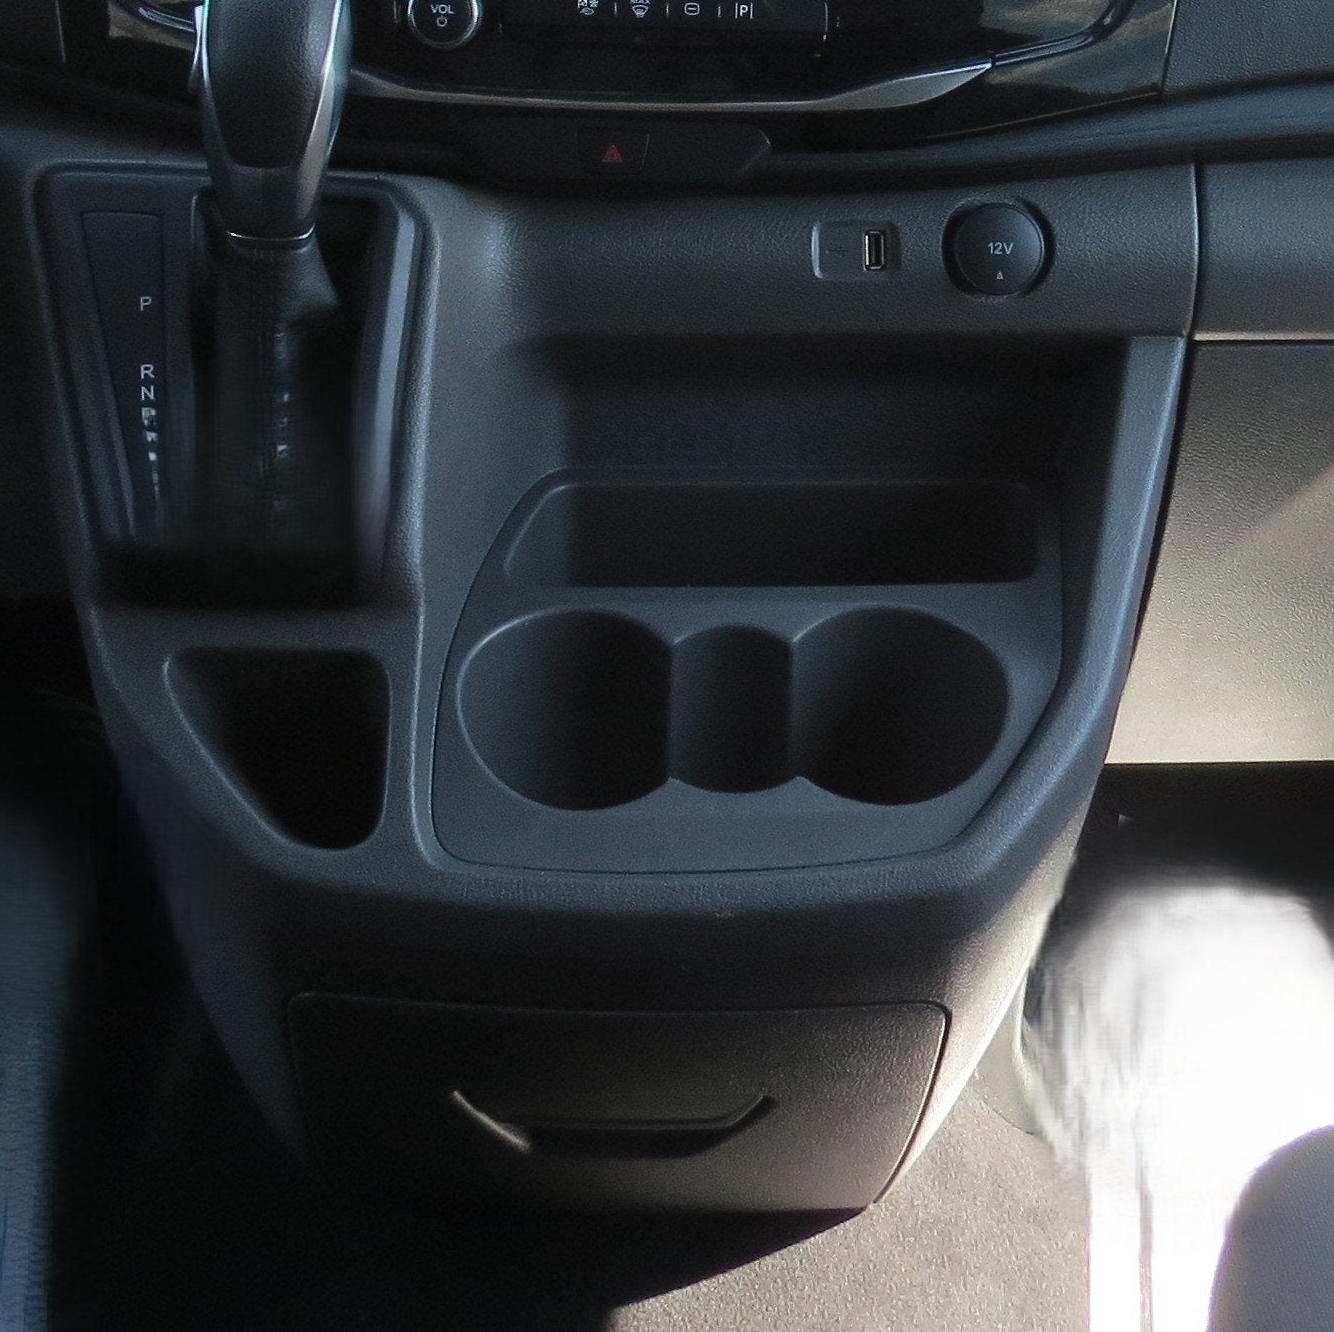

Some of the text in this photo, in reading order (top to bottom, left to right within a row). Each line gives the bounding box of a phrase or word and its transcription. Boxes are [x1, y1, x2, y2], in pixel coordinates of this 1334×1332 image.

[430, 4, 454, 15] VOL
[987, 242, 1014, 255] 12V
[139, 296, 153, 311] P
[140, 364, 155, 379] R
[141, 385, 155, 400] N
